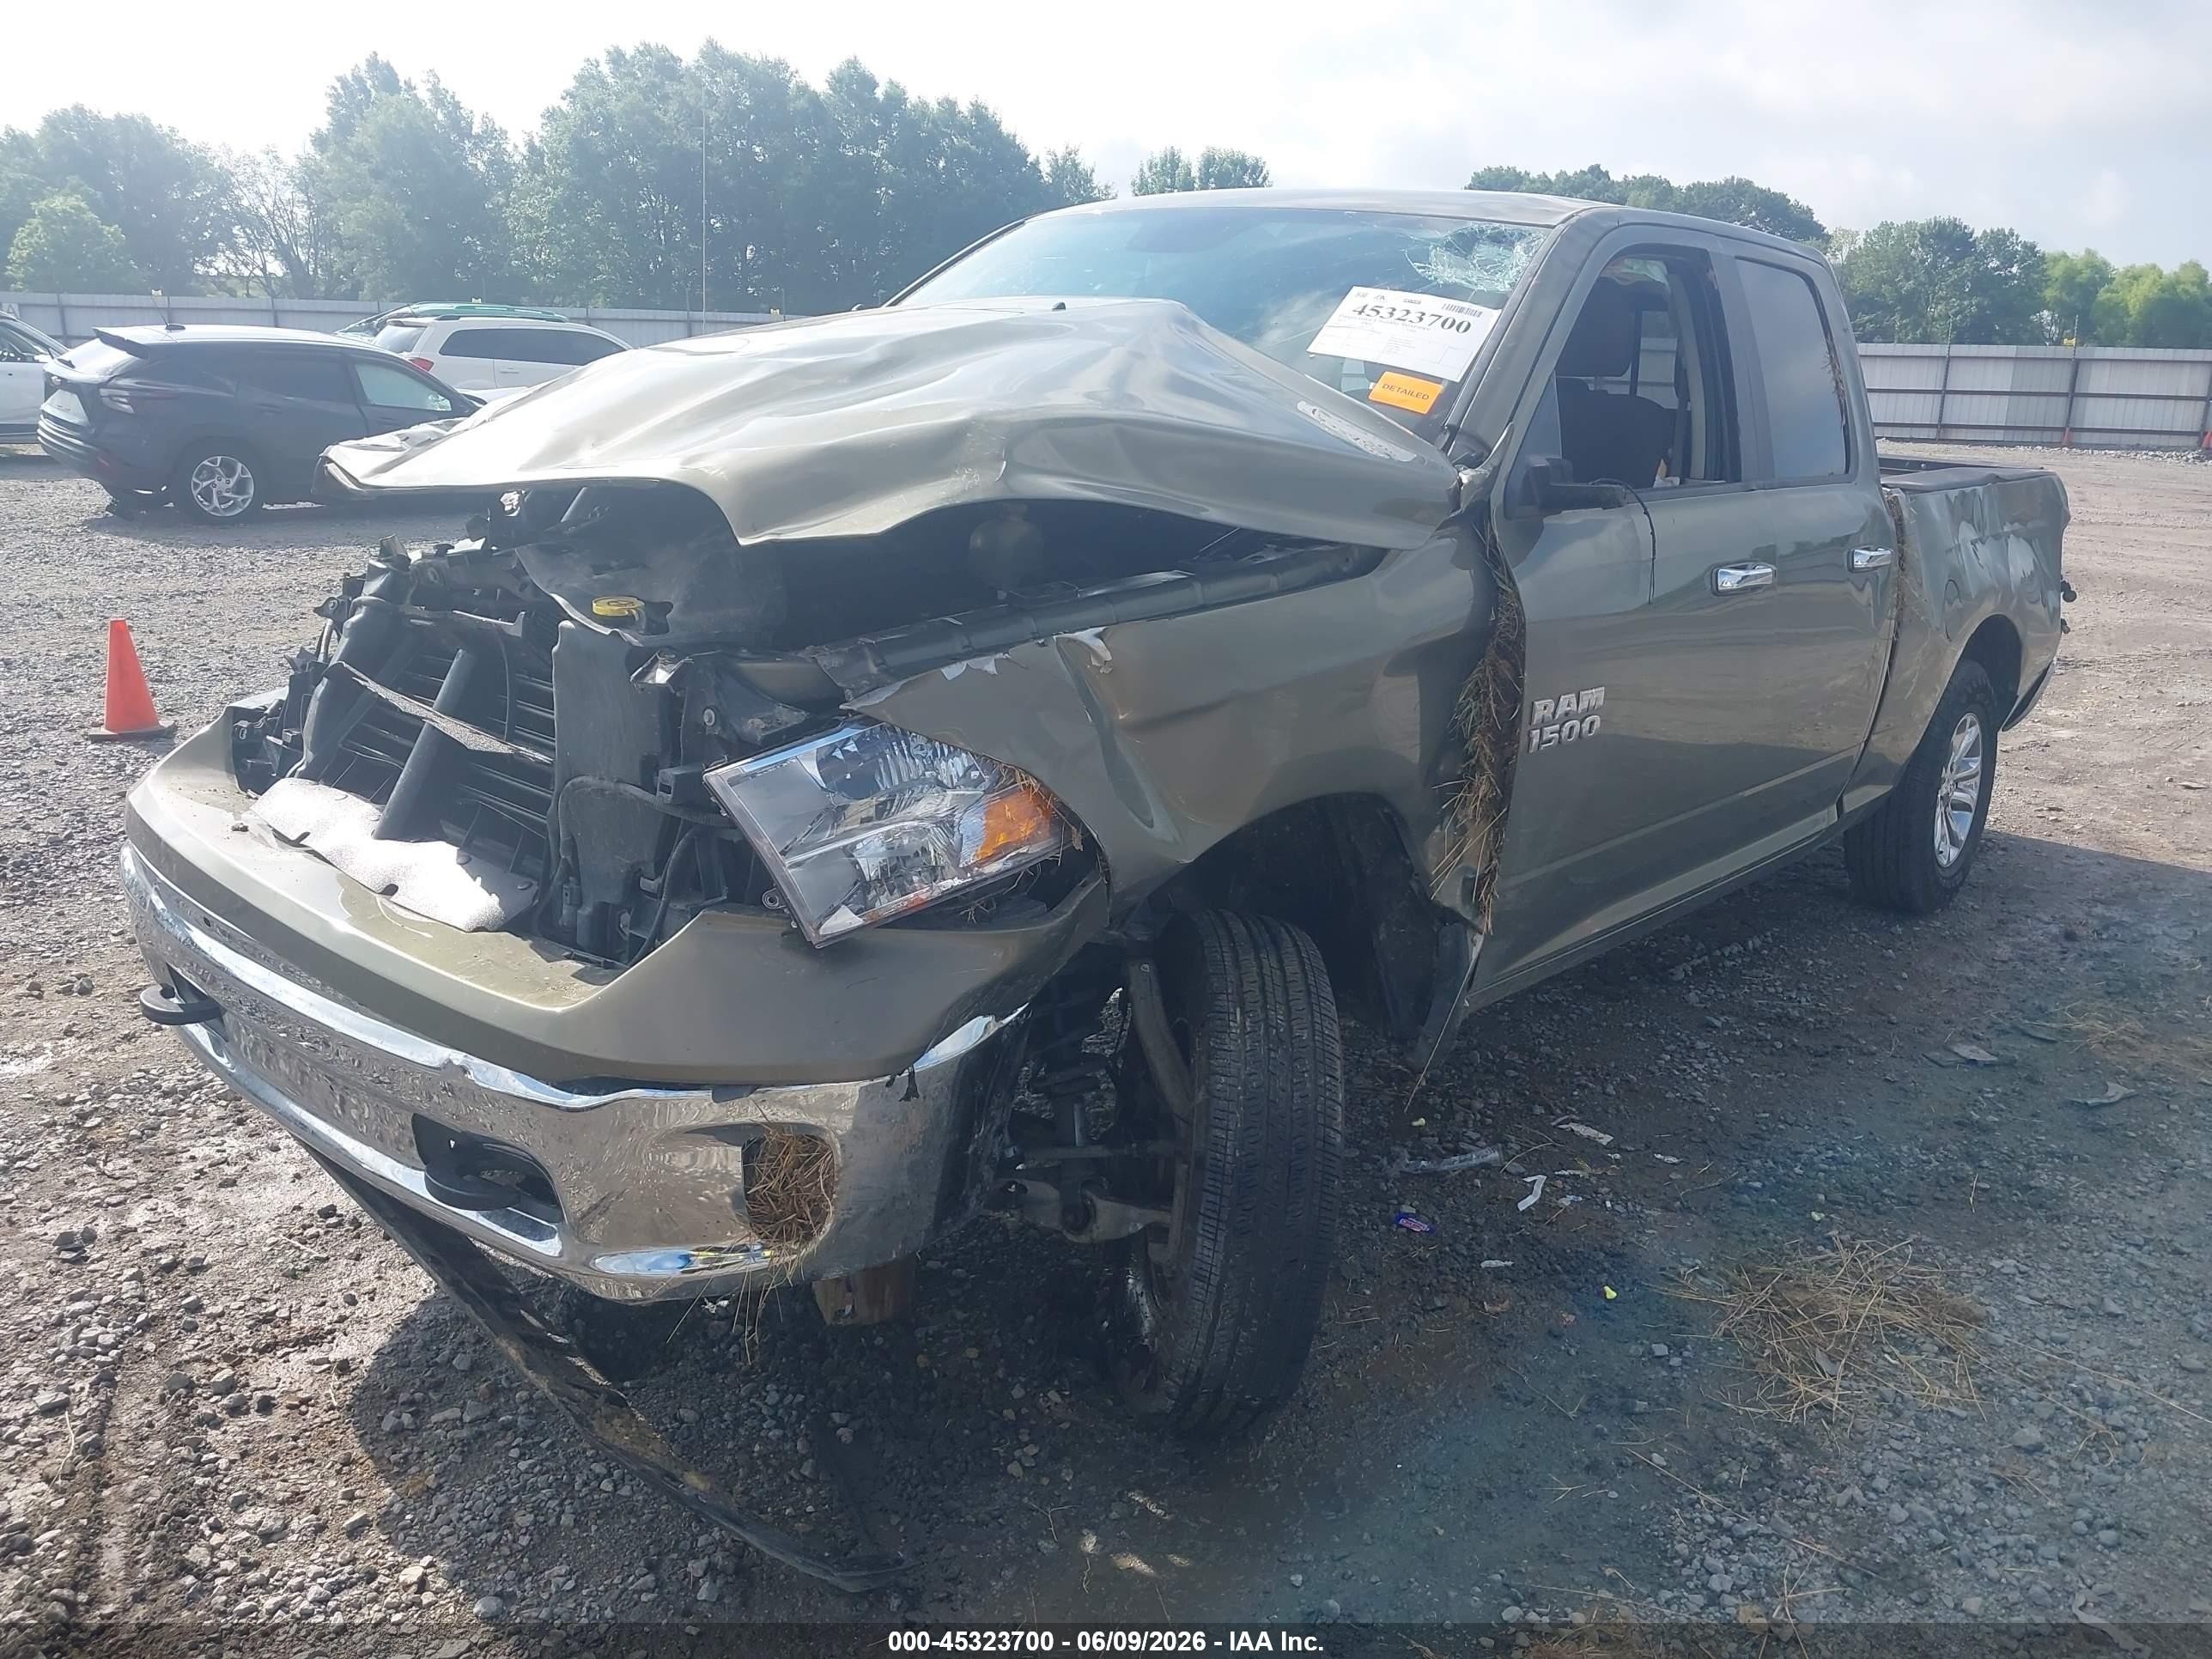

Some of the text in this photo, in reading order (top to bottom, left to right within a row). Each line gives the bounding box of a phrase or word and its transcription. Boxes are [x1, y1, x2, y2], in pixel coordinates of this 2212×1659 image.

[1352, 303, 1472, 335] 45323700
[1382, 383, 1430, 401] DETAILED
[1531, 686, 1605, 725] RAM
[1528, 714, 1601, 754] 1500
